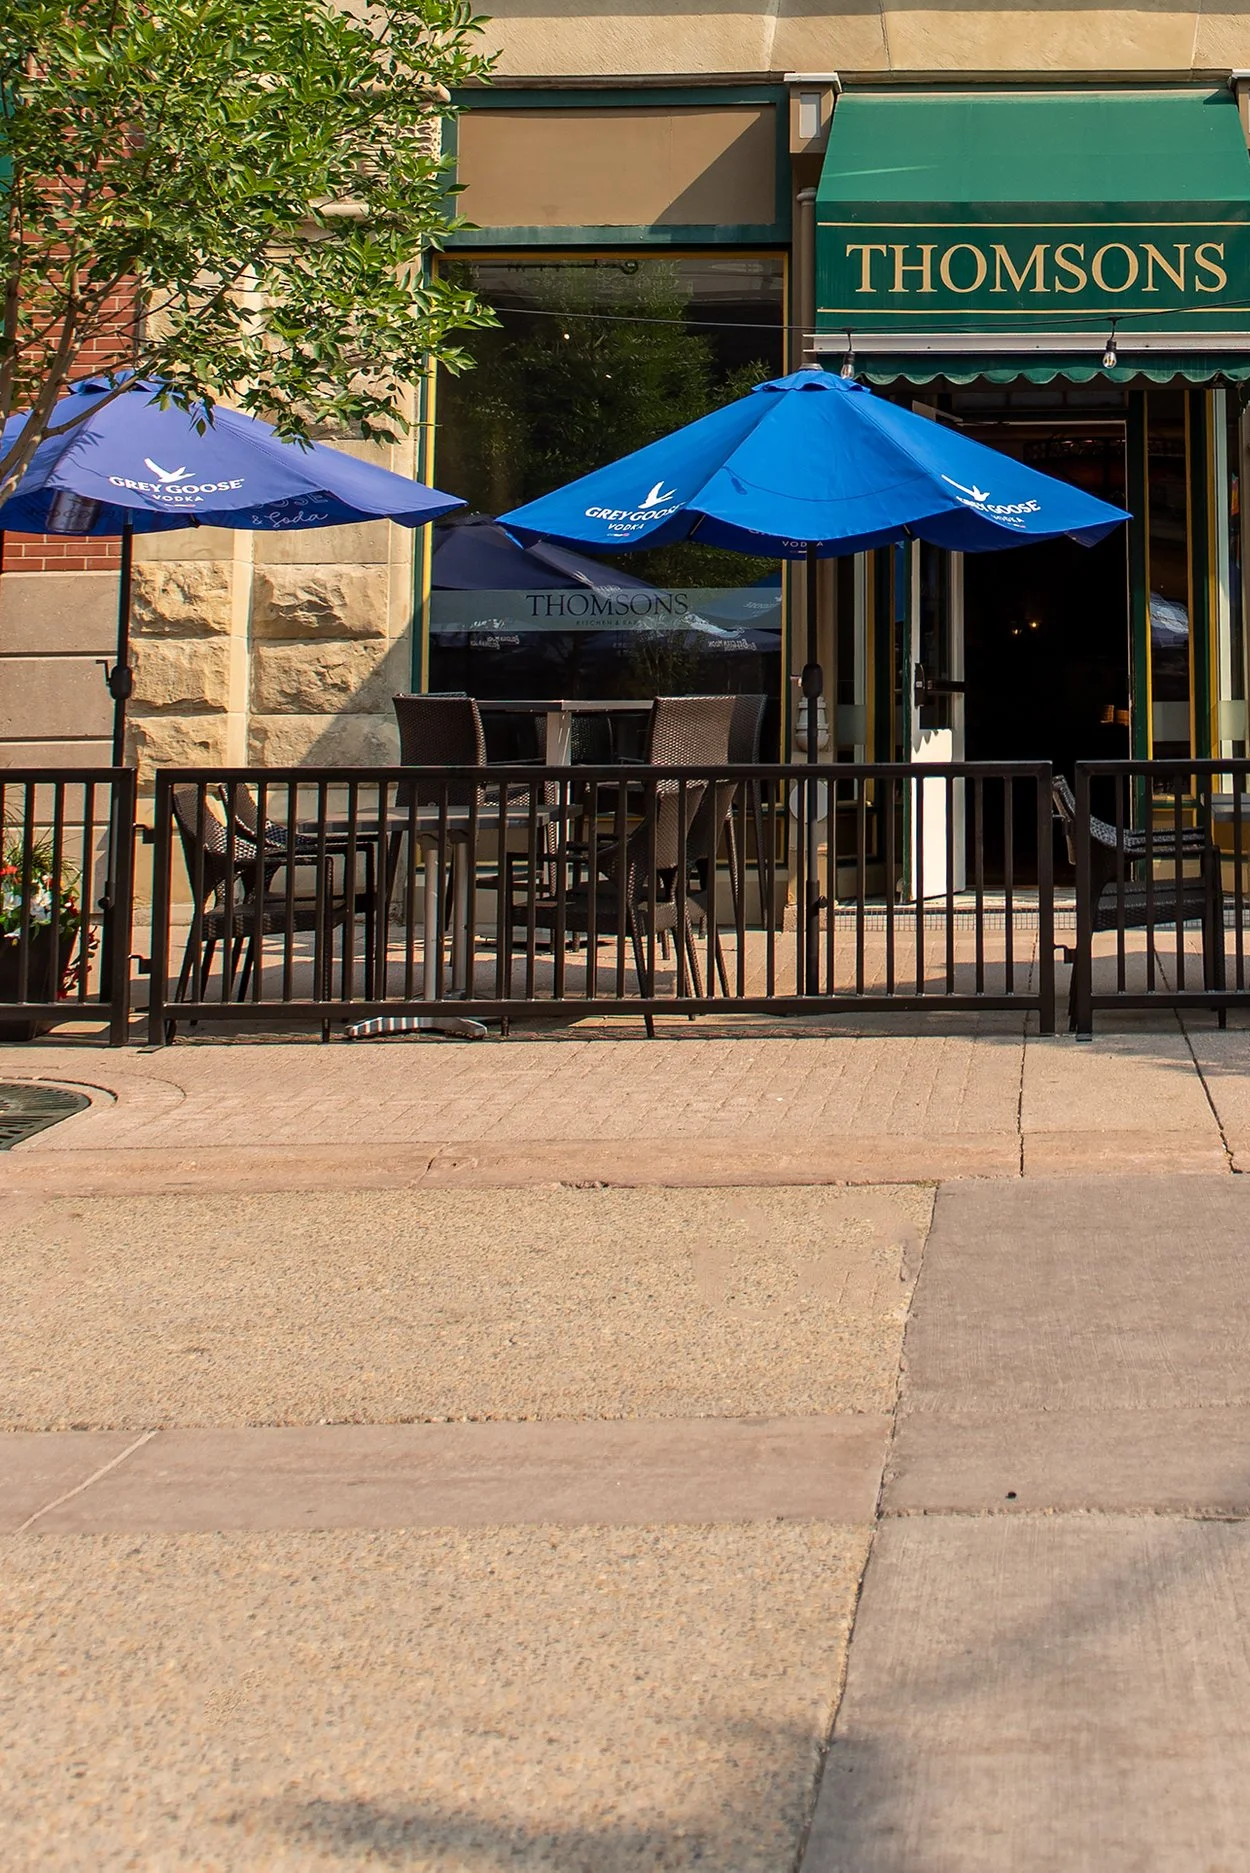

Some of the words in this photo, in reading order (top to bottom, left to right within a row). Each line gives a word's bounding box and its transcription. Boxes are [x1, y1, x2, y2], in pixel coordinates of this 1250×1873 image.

[846, 242, 1227, 294] THOMSONS
[109, 477, 163, 493] GREY
[165, 479, 243, 494] GOOSE
[152, 494, 204, 502] VODKA
[584, 506, 630, 522] GREY
[987, 499, 1041, 515] GOOSE
[264, 511, 328, 528] Soda
[607, 523, 644, 531] VODKA
[526, 593, 688, 617] THOMSONS
